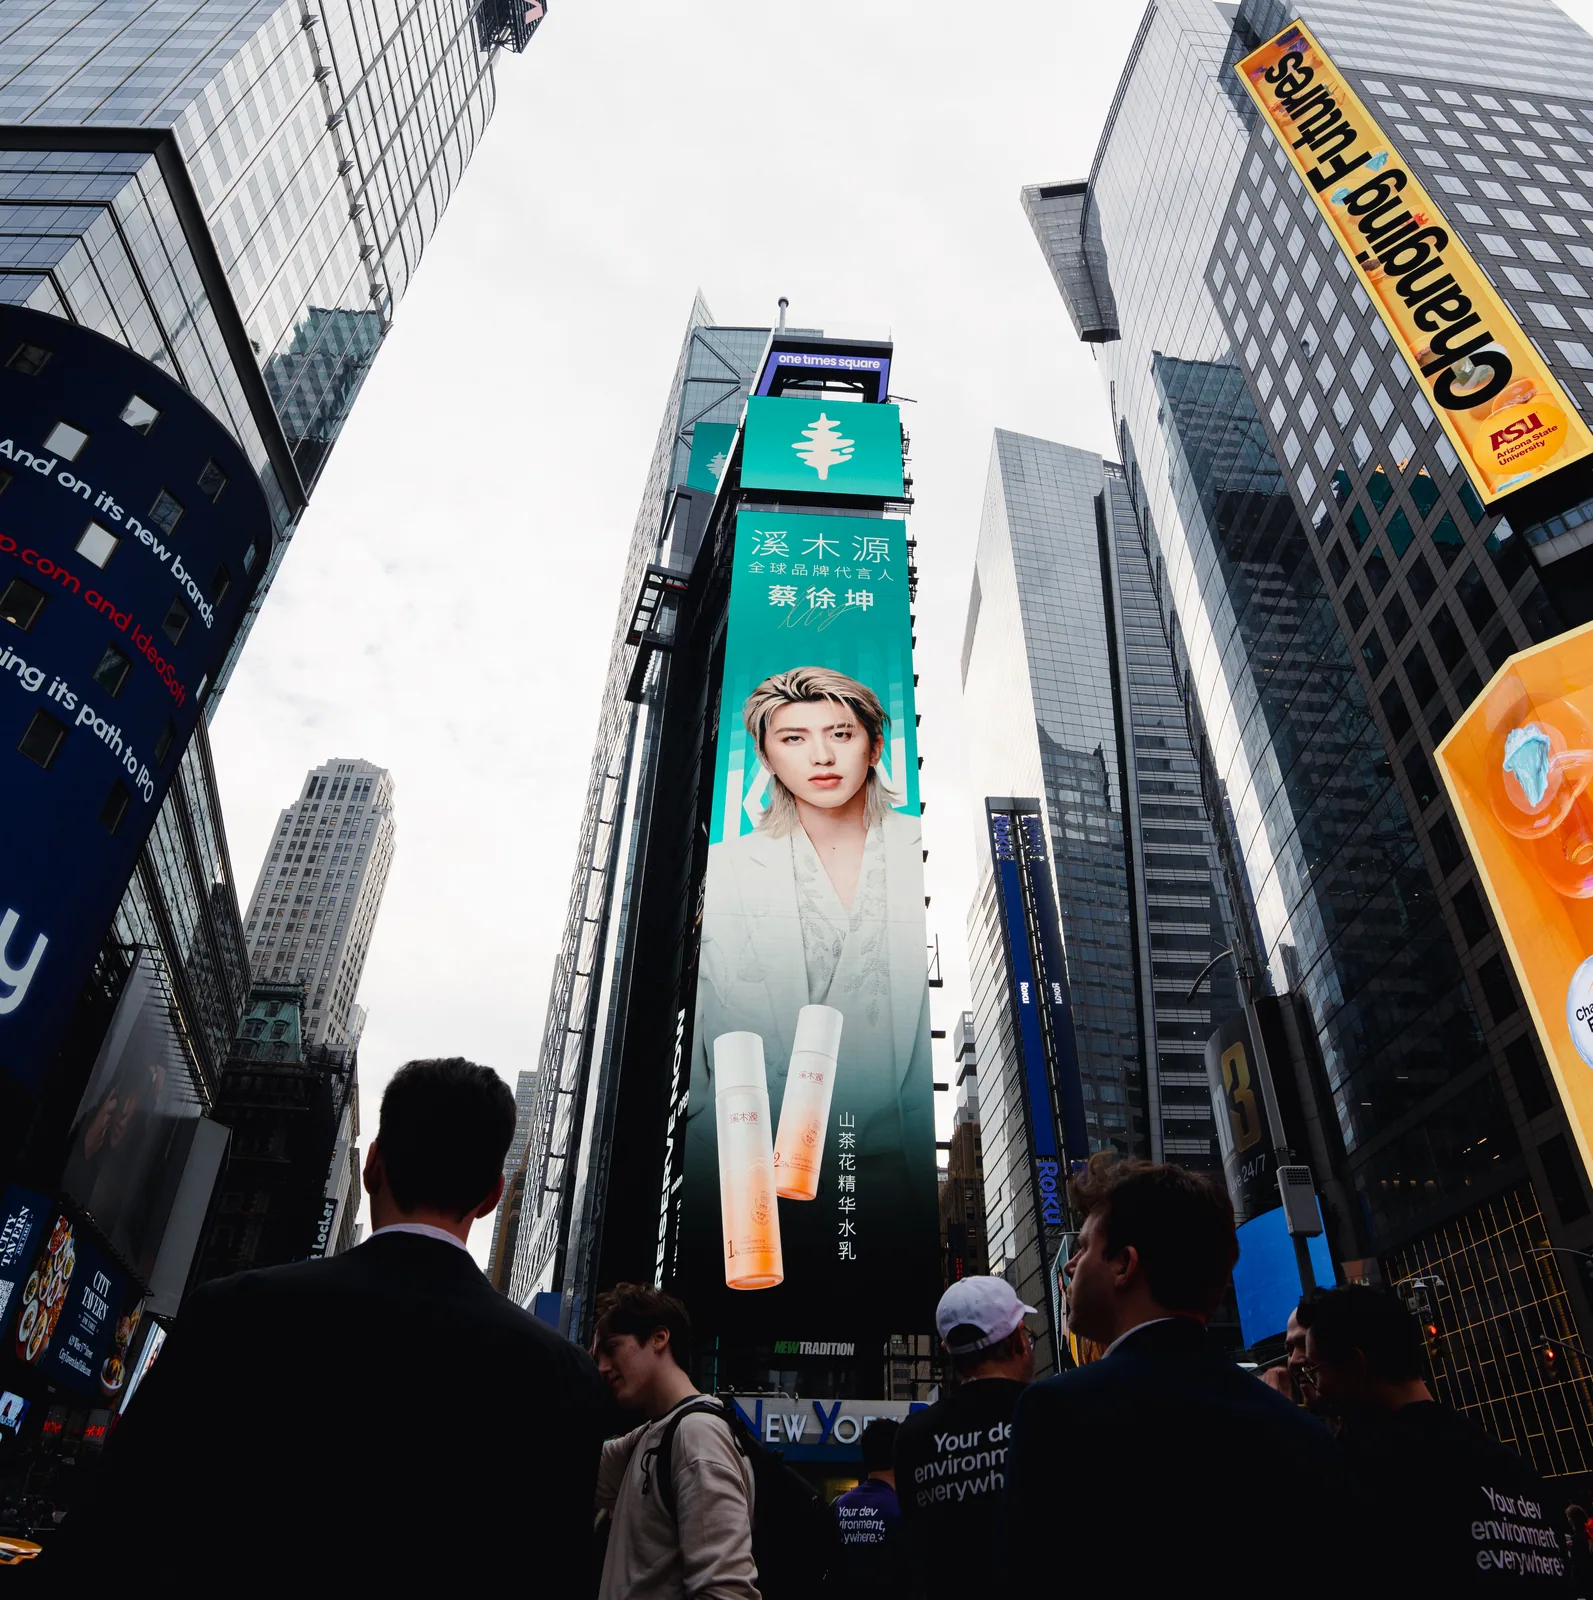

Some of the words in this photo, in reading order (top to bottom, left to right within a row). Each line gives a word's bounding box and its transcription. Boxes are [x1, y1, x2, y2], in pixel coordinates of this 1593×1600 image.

[1264, 51, 1373, 194] Futures
[1344, 168, 1513, 411] Changing
[778, 354, 802, 364] one
[803, 354, 837, 366] times
[838, 358, 881, 370] square
[1489, 412, 1545, 452] ASU
[1497, 438, 1533, 460] Arizona
[1531, 425, 1559, 441] State
[1498, 439, 1546, 466] University
[0, 438, 58, 477] And
[57, 471, 92, 500] on
[94, 490, 125, 521] its
[125, 516, 172, 562] new
[170, 554, 214, 629] brands
[751, 528, 891, 563] 溪木源
[748, 560, 894, 582] 全球品牌代言人
[767, 584, 874, 612] 蔡徐坤
[84, 588, 134, 633] and
[131, 623, 187, 709] IdeaSoft
[0, 645, 47, 693] ing
[47, 675, 79, 711] its
[74, 703, 124, 757] path
[122, 745, 138, 775] to
[135, 763, 154, 804] IPO
[1221, 1041, 1262, 1153] 3
[837, 1111, 857, 1260] 山茶花精华水乳
[1241, 1153, 1266, 1183] 24/7
[1, 1205, 30, 1267] TAVERN
[311, 1202, 334, 1250] Locker
[93, 1270, 112, 1299] CITY
[81, 1285, 110, 1322] TAVERN
[933, 1430, 983, 1454] Your
[916, 1469, 1005, 1507] everywh
[1481, 1485, 1517, 1516] Your
[1517, 1494, 1543, 1520] dev
[839, 1506, 859, 1518] Your
[859, 1505, 879, 1517] dev
